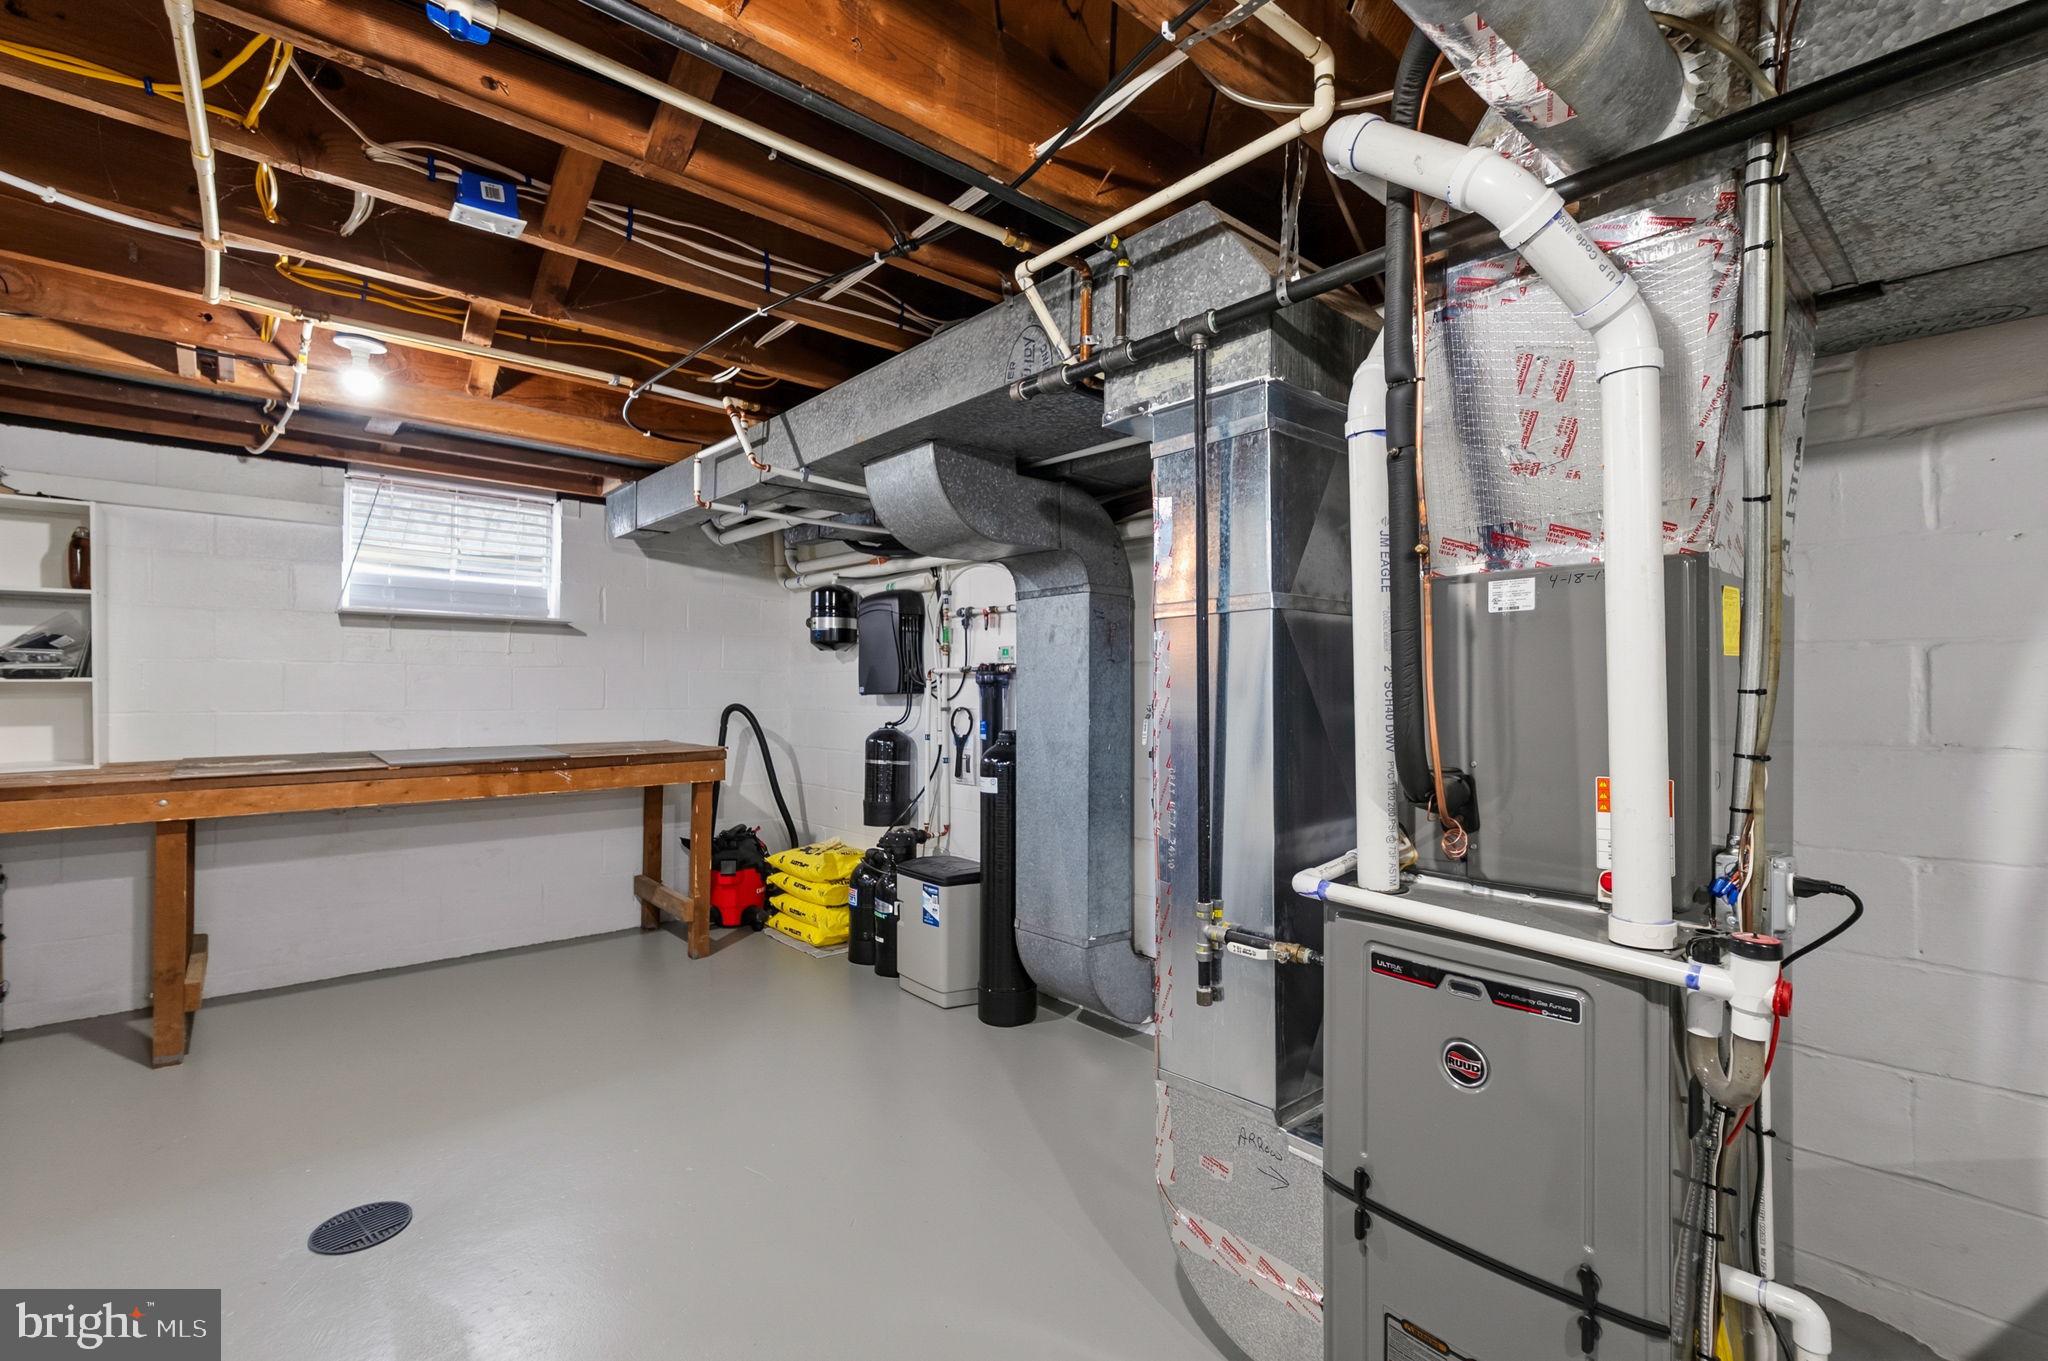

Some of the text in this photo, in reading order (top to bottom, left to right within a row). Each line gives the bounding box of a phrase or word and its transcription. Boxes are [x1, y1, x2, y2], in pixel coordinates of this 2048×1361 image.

[1575, 232, 1599, 261] Code
[1549, 525, 1593, 543] VentureTape
[1380, 530, 1391, 593] JM EAGLE
[1549, 571, 1605, 589] 4-18-1
[1387, 760, 1396, 779] PVC
[1388, 862, 1397, 887] ASTM
[1376, 960, 1402, 972] ULTRA
[1548, 1001, 1573, 1013] Furnace
[1448, 1056, 1481, 1073] RUUD
